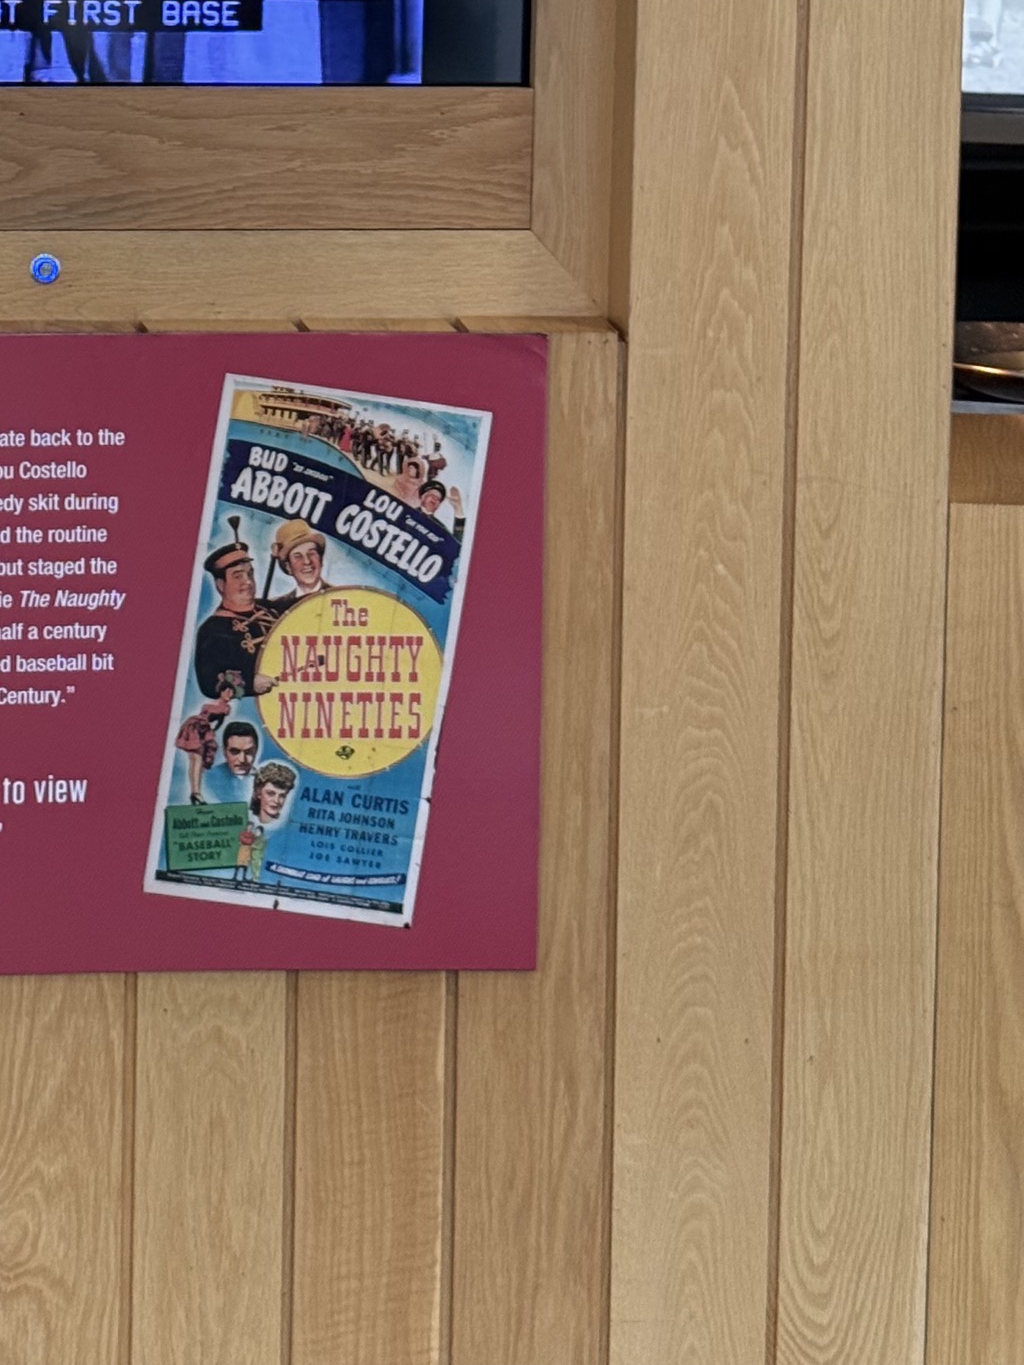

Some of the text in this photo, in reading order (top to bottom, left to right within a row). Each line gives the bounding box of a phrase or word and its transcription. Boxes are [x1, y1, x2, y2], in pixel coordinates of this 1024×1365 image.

[43, 0, 143, 26] FIRST
[162, 0, 240, 27] BASE
[30, 428, 72, 447] back
[76, 428, 94, 446] to
[97, 428, 126, 446] the
[18, 460, 88, 480] Costello
[248, 446, 289, 472] BUD
[27, 493, 60, 512] skit
[63, 492, 119, 515] during
[231, 467, 333, 524] ABBOTT
[363, 489, 403, 522] LOU
[15, 525, 44, 544] the
[47, 524, 108, 544] routine
[335, 504, 444, 583] COSTELLO
[27, 557, 86, 580] staged
[89, 556, 118, 575] the
[19, 589, 51, 608] The
[53, 588, 127, 611] Naughty
[331, 599, 369, 627] The
[27, 625, 39, 641] a
[42, 621, 108, 643] century
[15, 653, 87, 673] baseball
[91, 652, 115, 671] bit
[280, 635, 424, 682] NAUGHTY
[277, 692, 422, 739] NINETIES
[2, 777, 26, 805] to
[33, 774, 88, 804] view
[300, 786, 410, 815] ALAN CURTIS
[307, 807, 396, 829] RITA JOHNSON
[298, 823, 399, 846] HENRY TRAVERS
[187, 850, 222, 862] STORY
